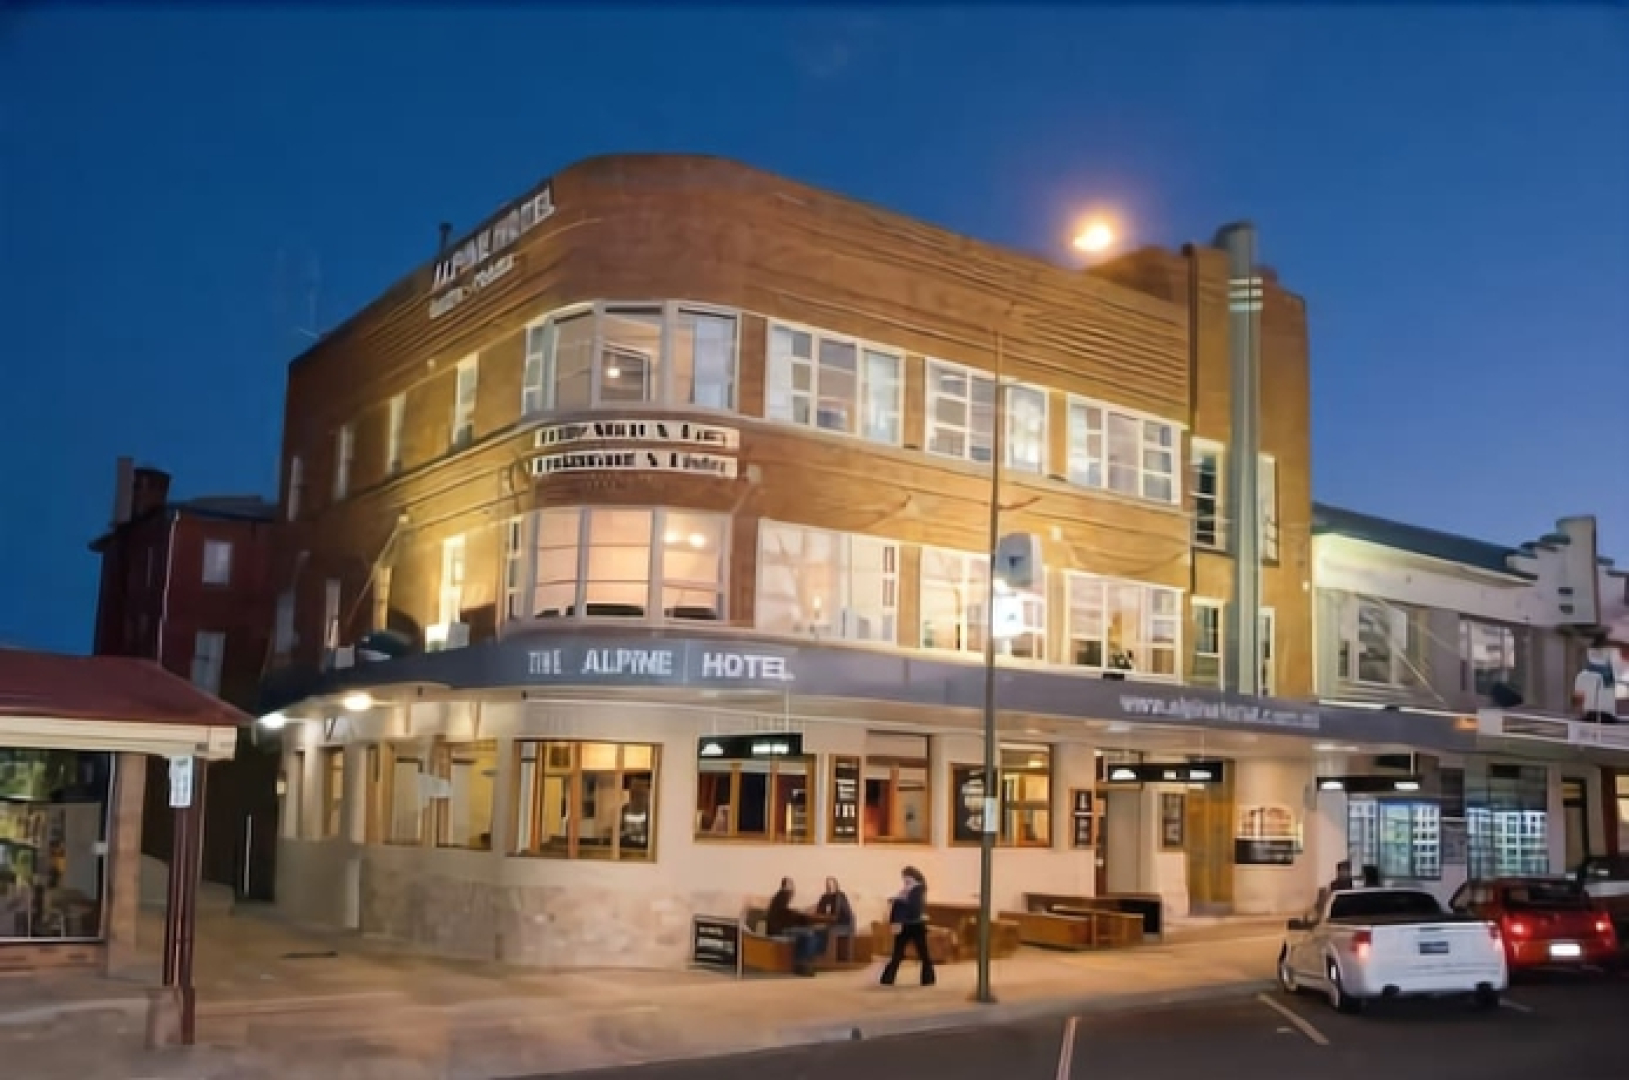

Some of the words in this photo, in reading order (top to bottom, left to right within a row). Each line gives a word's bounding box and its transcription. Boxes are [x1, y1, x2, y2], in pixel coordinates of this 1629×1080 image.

[493, 183, 556, 253] HOTEL
[581, 647, 672, 675] ALPINE
[701, 651, 796, 682] HOTEL
